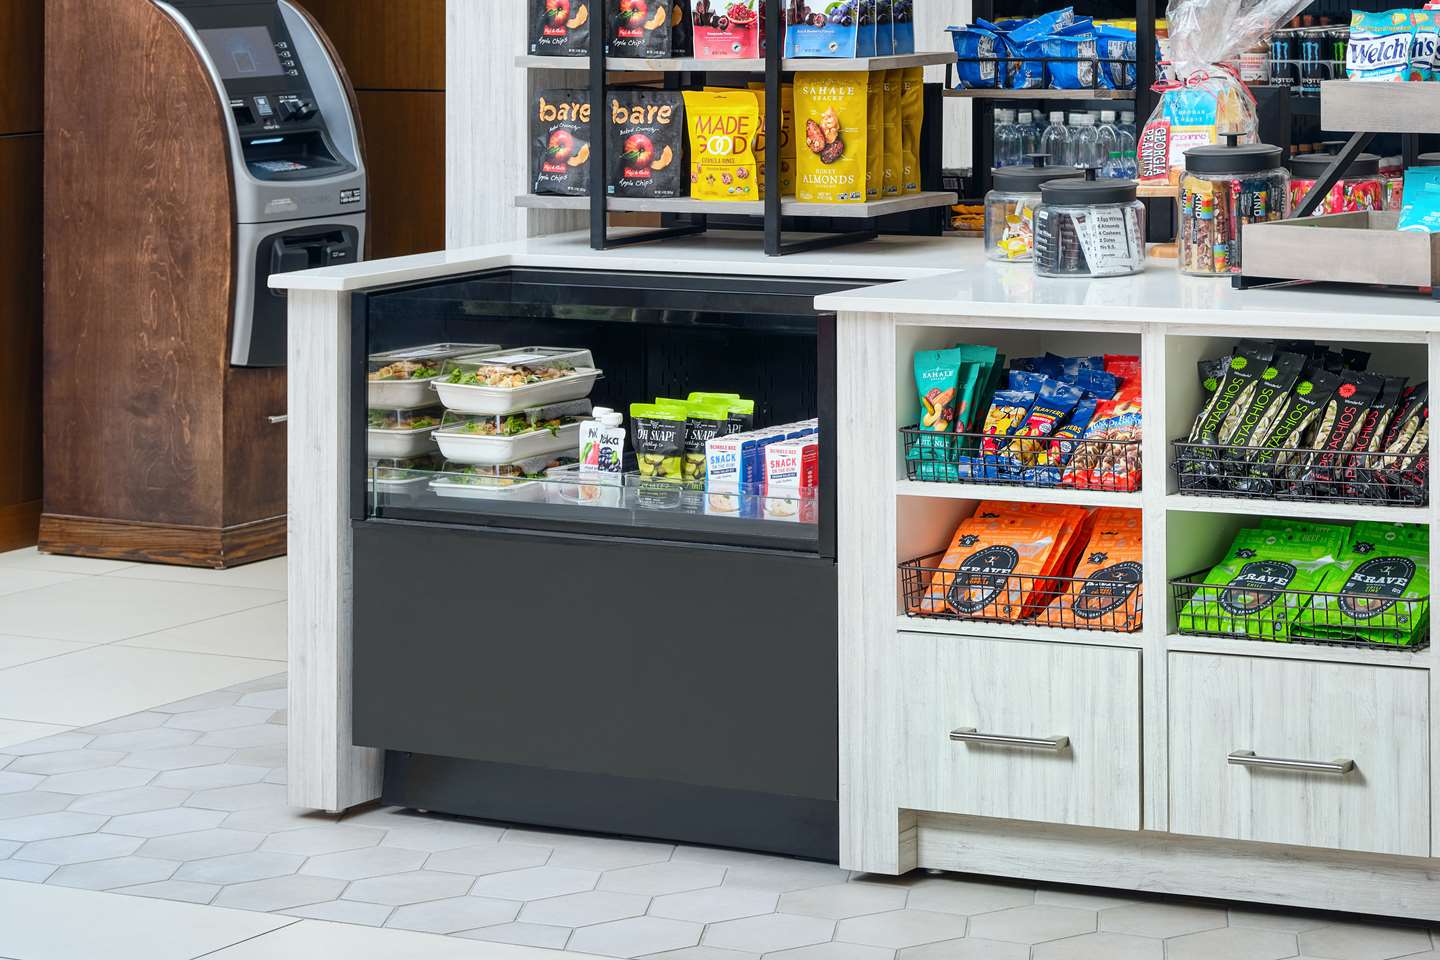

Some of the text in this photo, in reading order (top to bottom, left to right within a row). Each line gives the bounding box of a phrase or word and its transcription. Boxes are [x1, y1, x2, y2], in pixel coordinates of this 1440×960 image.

[803, 86, 855, 96] SAHALE
[540, 97, 590, 123] bare
[612, 99, 673, 124] bare
[695, 116, 749, 135] MADE
[1142, 129, 1154, 177] PEANUTS
[1154, 127, 1167, 175] GEORGIA
[803, 174, 855, 185] ALMONDS
[1034, 406, 1066, 418] PLANTERS
[1201, 377, 1244, 441] PISTACHIOS
[711, 453, 736, 464] SNACK
[770, 458, 797, 468] SNACK
[1351, 572, 1408, 587] KRAVE
